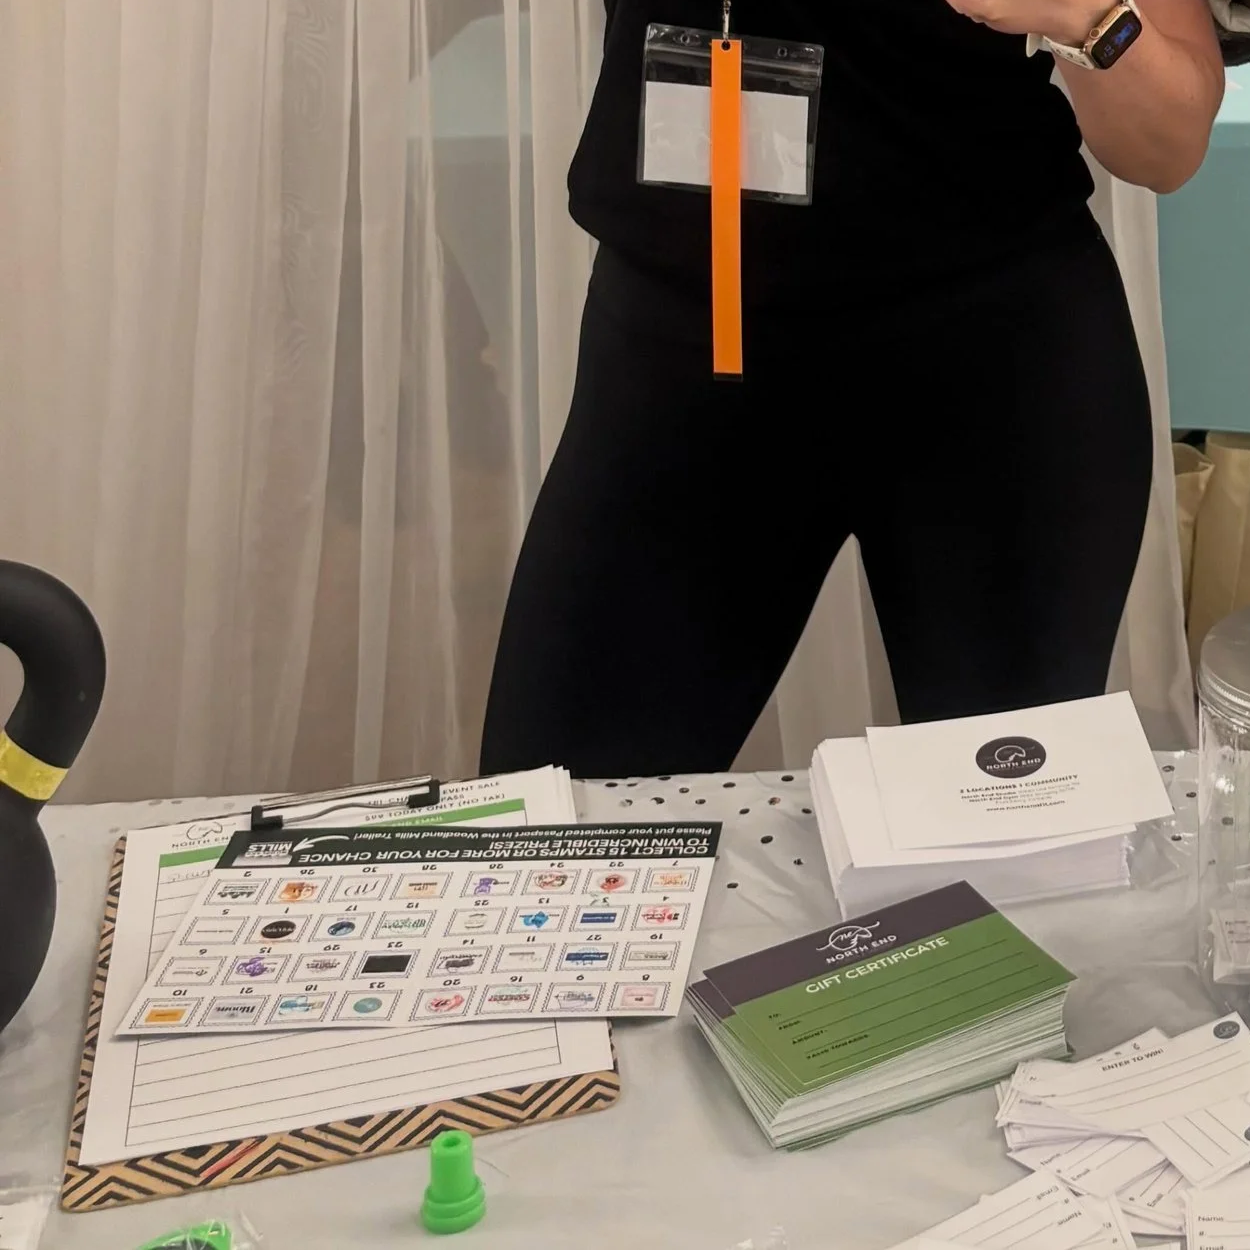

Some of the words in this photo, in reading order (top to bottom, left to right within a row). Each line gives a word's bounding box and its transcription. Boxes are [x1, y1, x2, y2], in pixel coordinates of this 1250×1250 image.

[986, 761, 1019, 770] NORTH
[1021, 757, 1041, 766] END
[442, 784, 474, 795] EVENT
[478, 781, 501, 790] SALE
[966, 784, 1017, 793] LOCATIONS
[1025, 774, 1079, 787] COMMUNITY
[514, 829, 563, 838] Passport
[563, 827, 627, 837] completed
[628, 827, 653, 835] your
[655, 826, 674, 834] put
[675, 826, 712, 835] Please
[395, 832, 420, 841] Mills
[422, 831, 479, 841] Woodland
[481, 832, 498, 840] the
[171, 838, 212, 849] NORTH
[489, 840, 551, 849] PRIZES!
[553, 838, 649, 848] INCREDIBLE
[651, 837, 685, 846] WIN
[686, 837, 710, 846] TO
[248, 842, 293, 853] MILLS
[512, 848, 538, 857] OR
[541, 847, 606, 856] STAMPS
[607, 846, 629, 856] 15
[630, 846, 709, 856] COLLECT
[299, 851, 372, 863] CHANCE
[376, 850, 423, 861] YOUR
[426, 850, 460, 860] FOR
[462, 849, 510, 859] MORE
[826, 944, 869, 964] NORTH
[871, 935, 898, 948] END
[805, 974, 843, 994] GIFT
[845, 936, 950, 979] CERTIFICATE
[510, 975, 523, 983] 16
[172, 989, 188, 997] 10
[1101, 1059, 1130, 1072] ENTER
[1132, 1055, 1144, 1063] TO
[1144, 1048, 1164, 1060] WIN!
